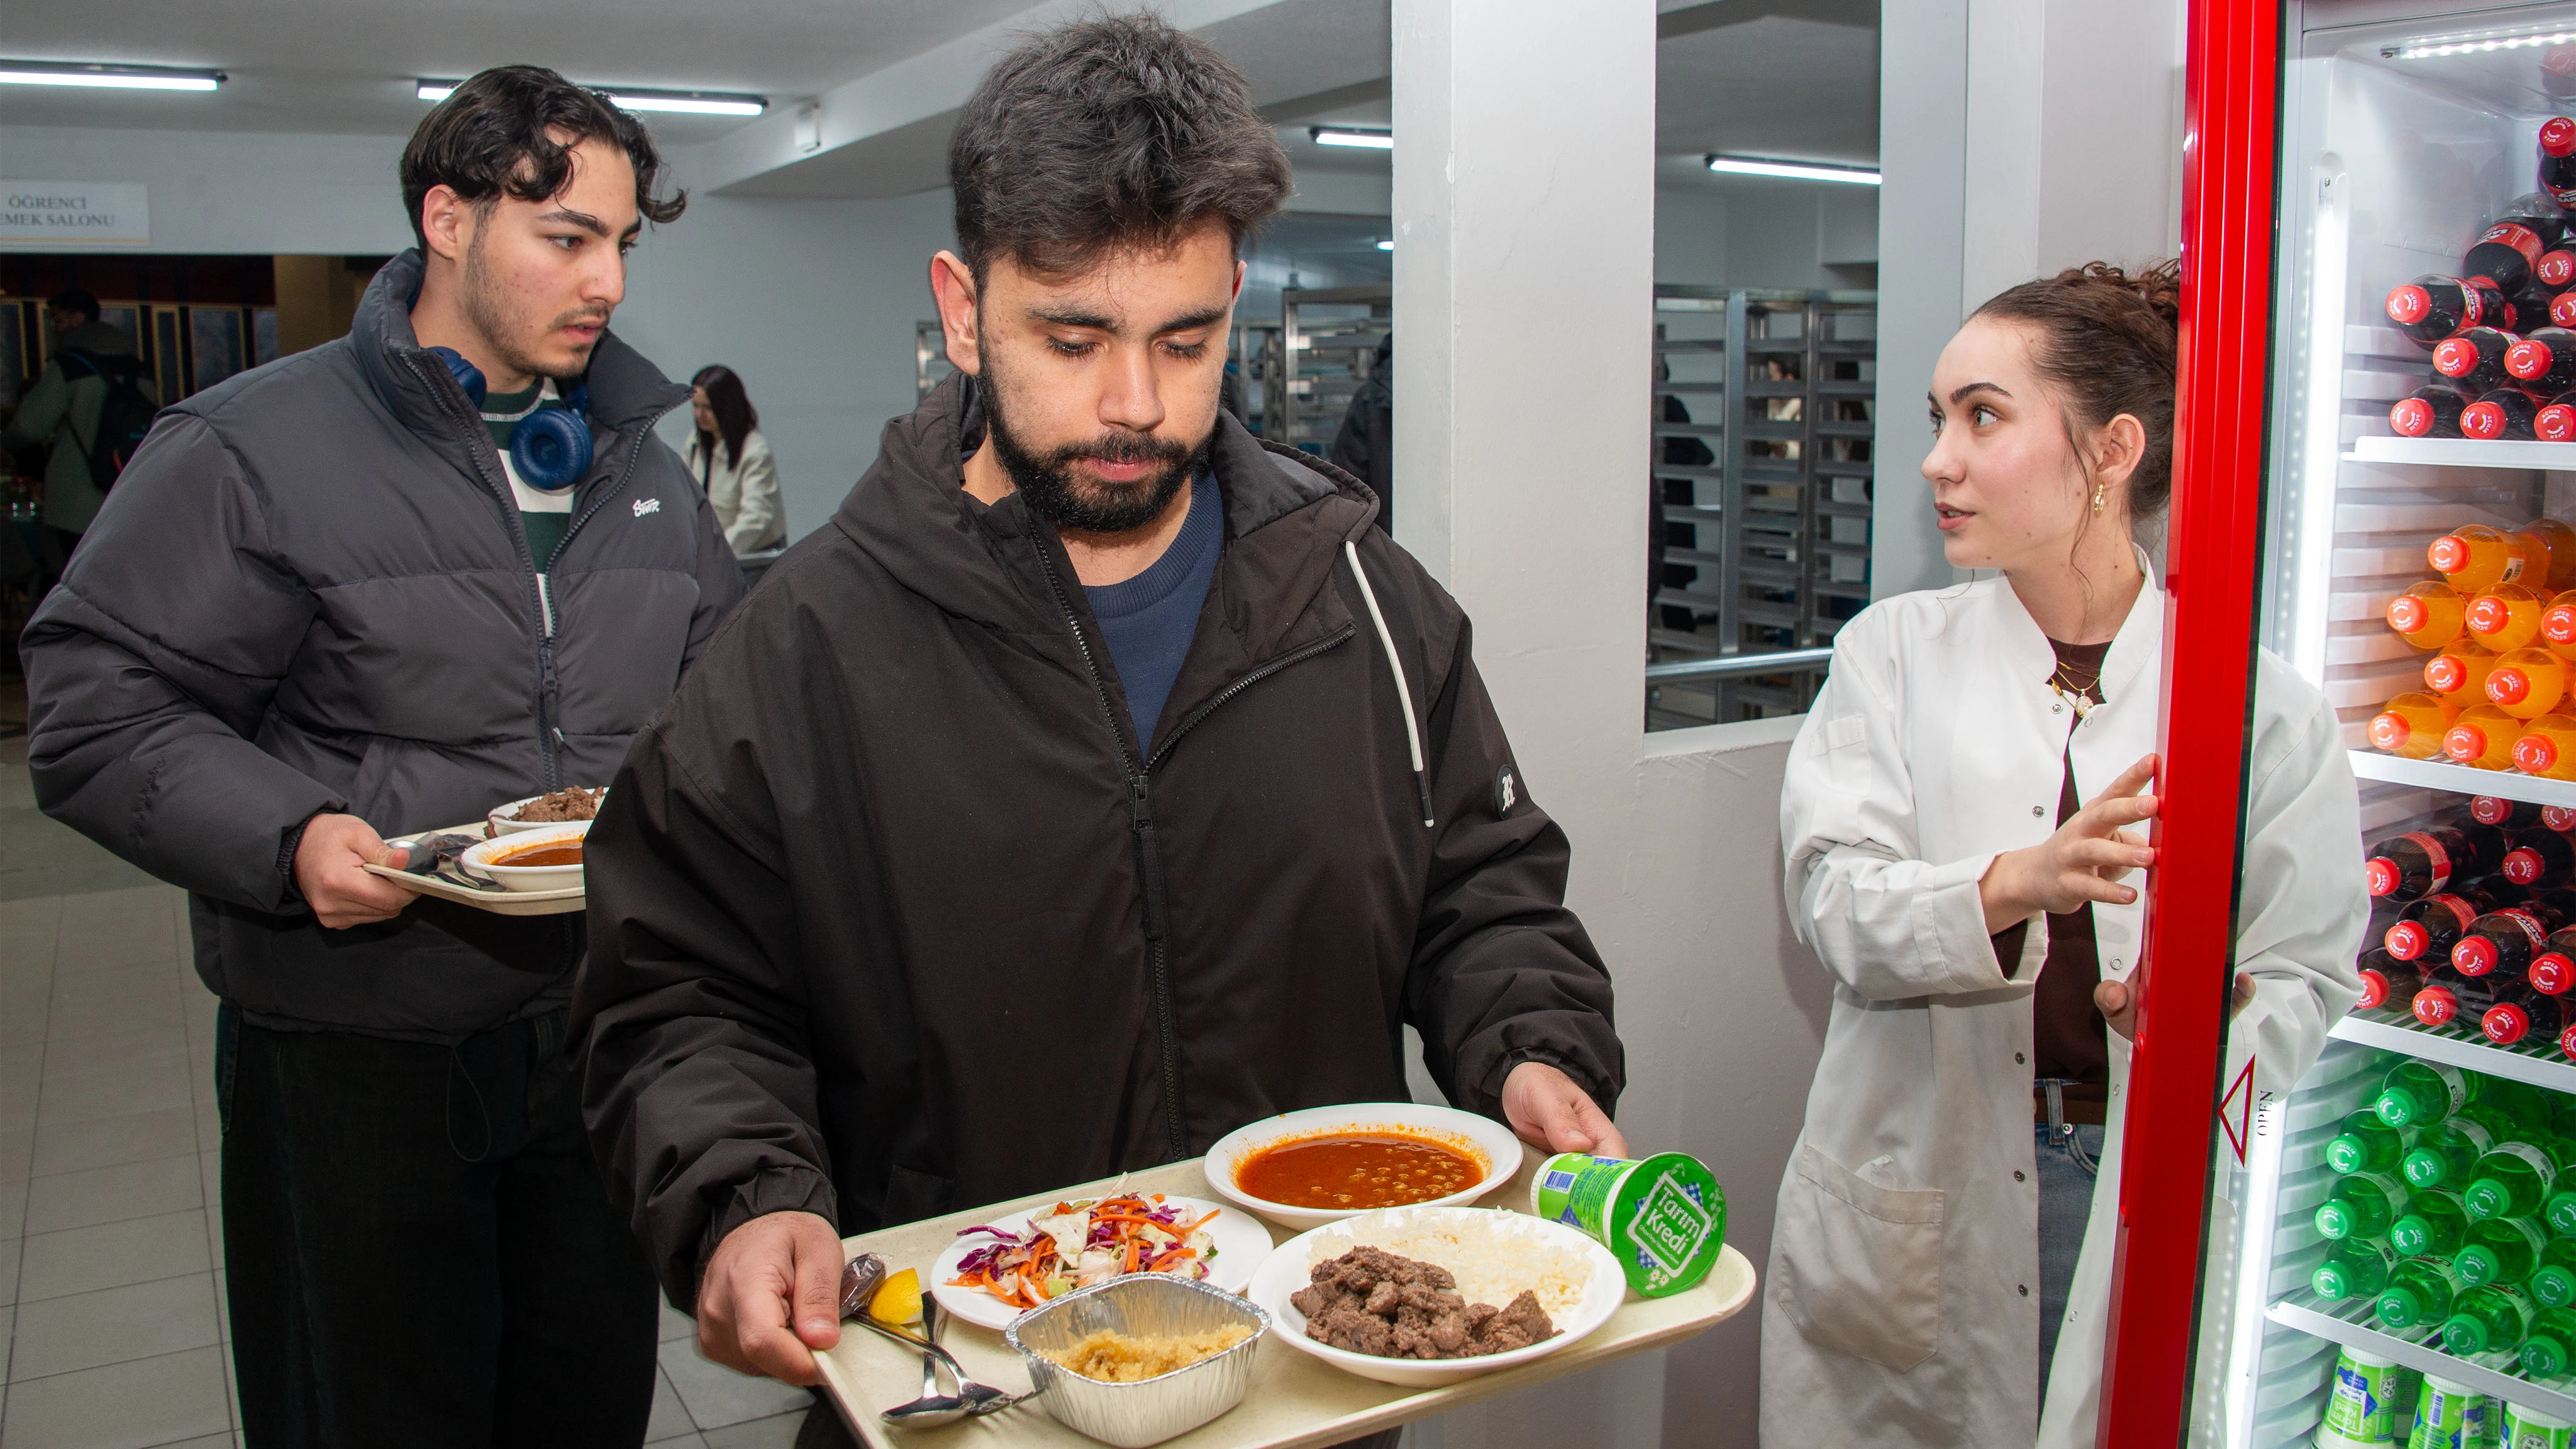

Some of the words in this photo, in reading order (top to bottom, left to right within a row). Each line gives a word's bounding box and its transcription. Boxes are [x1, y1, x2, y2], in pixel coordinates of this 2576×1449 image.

[47, 214, 115, 227] SALONU
[2519, 366, 2534, 374] OPEN
[2392, 406, 2401, 421] OPEN
[2550, 431, 2565, 439] OPEN
[2429, 660, 2443, 669] OPEN
[2507, 674, 2518, 688] OPEN
[2400, 928, 2414, 939] OPEN
[2454, 945, 2465, 957] OPEN
[2543, 961, 2558, 970] OPEN
[2501, 1013, 2513, 1025] OPEN
[2257, 1090, 2273, 1136] OPEN
[1658, 1186, 1700, 1239] Tarım
[1646, 1208, 1690, 1255] Kredi
